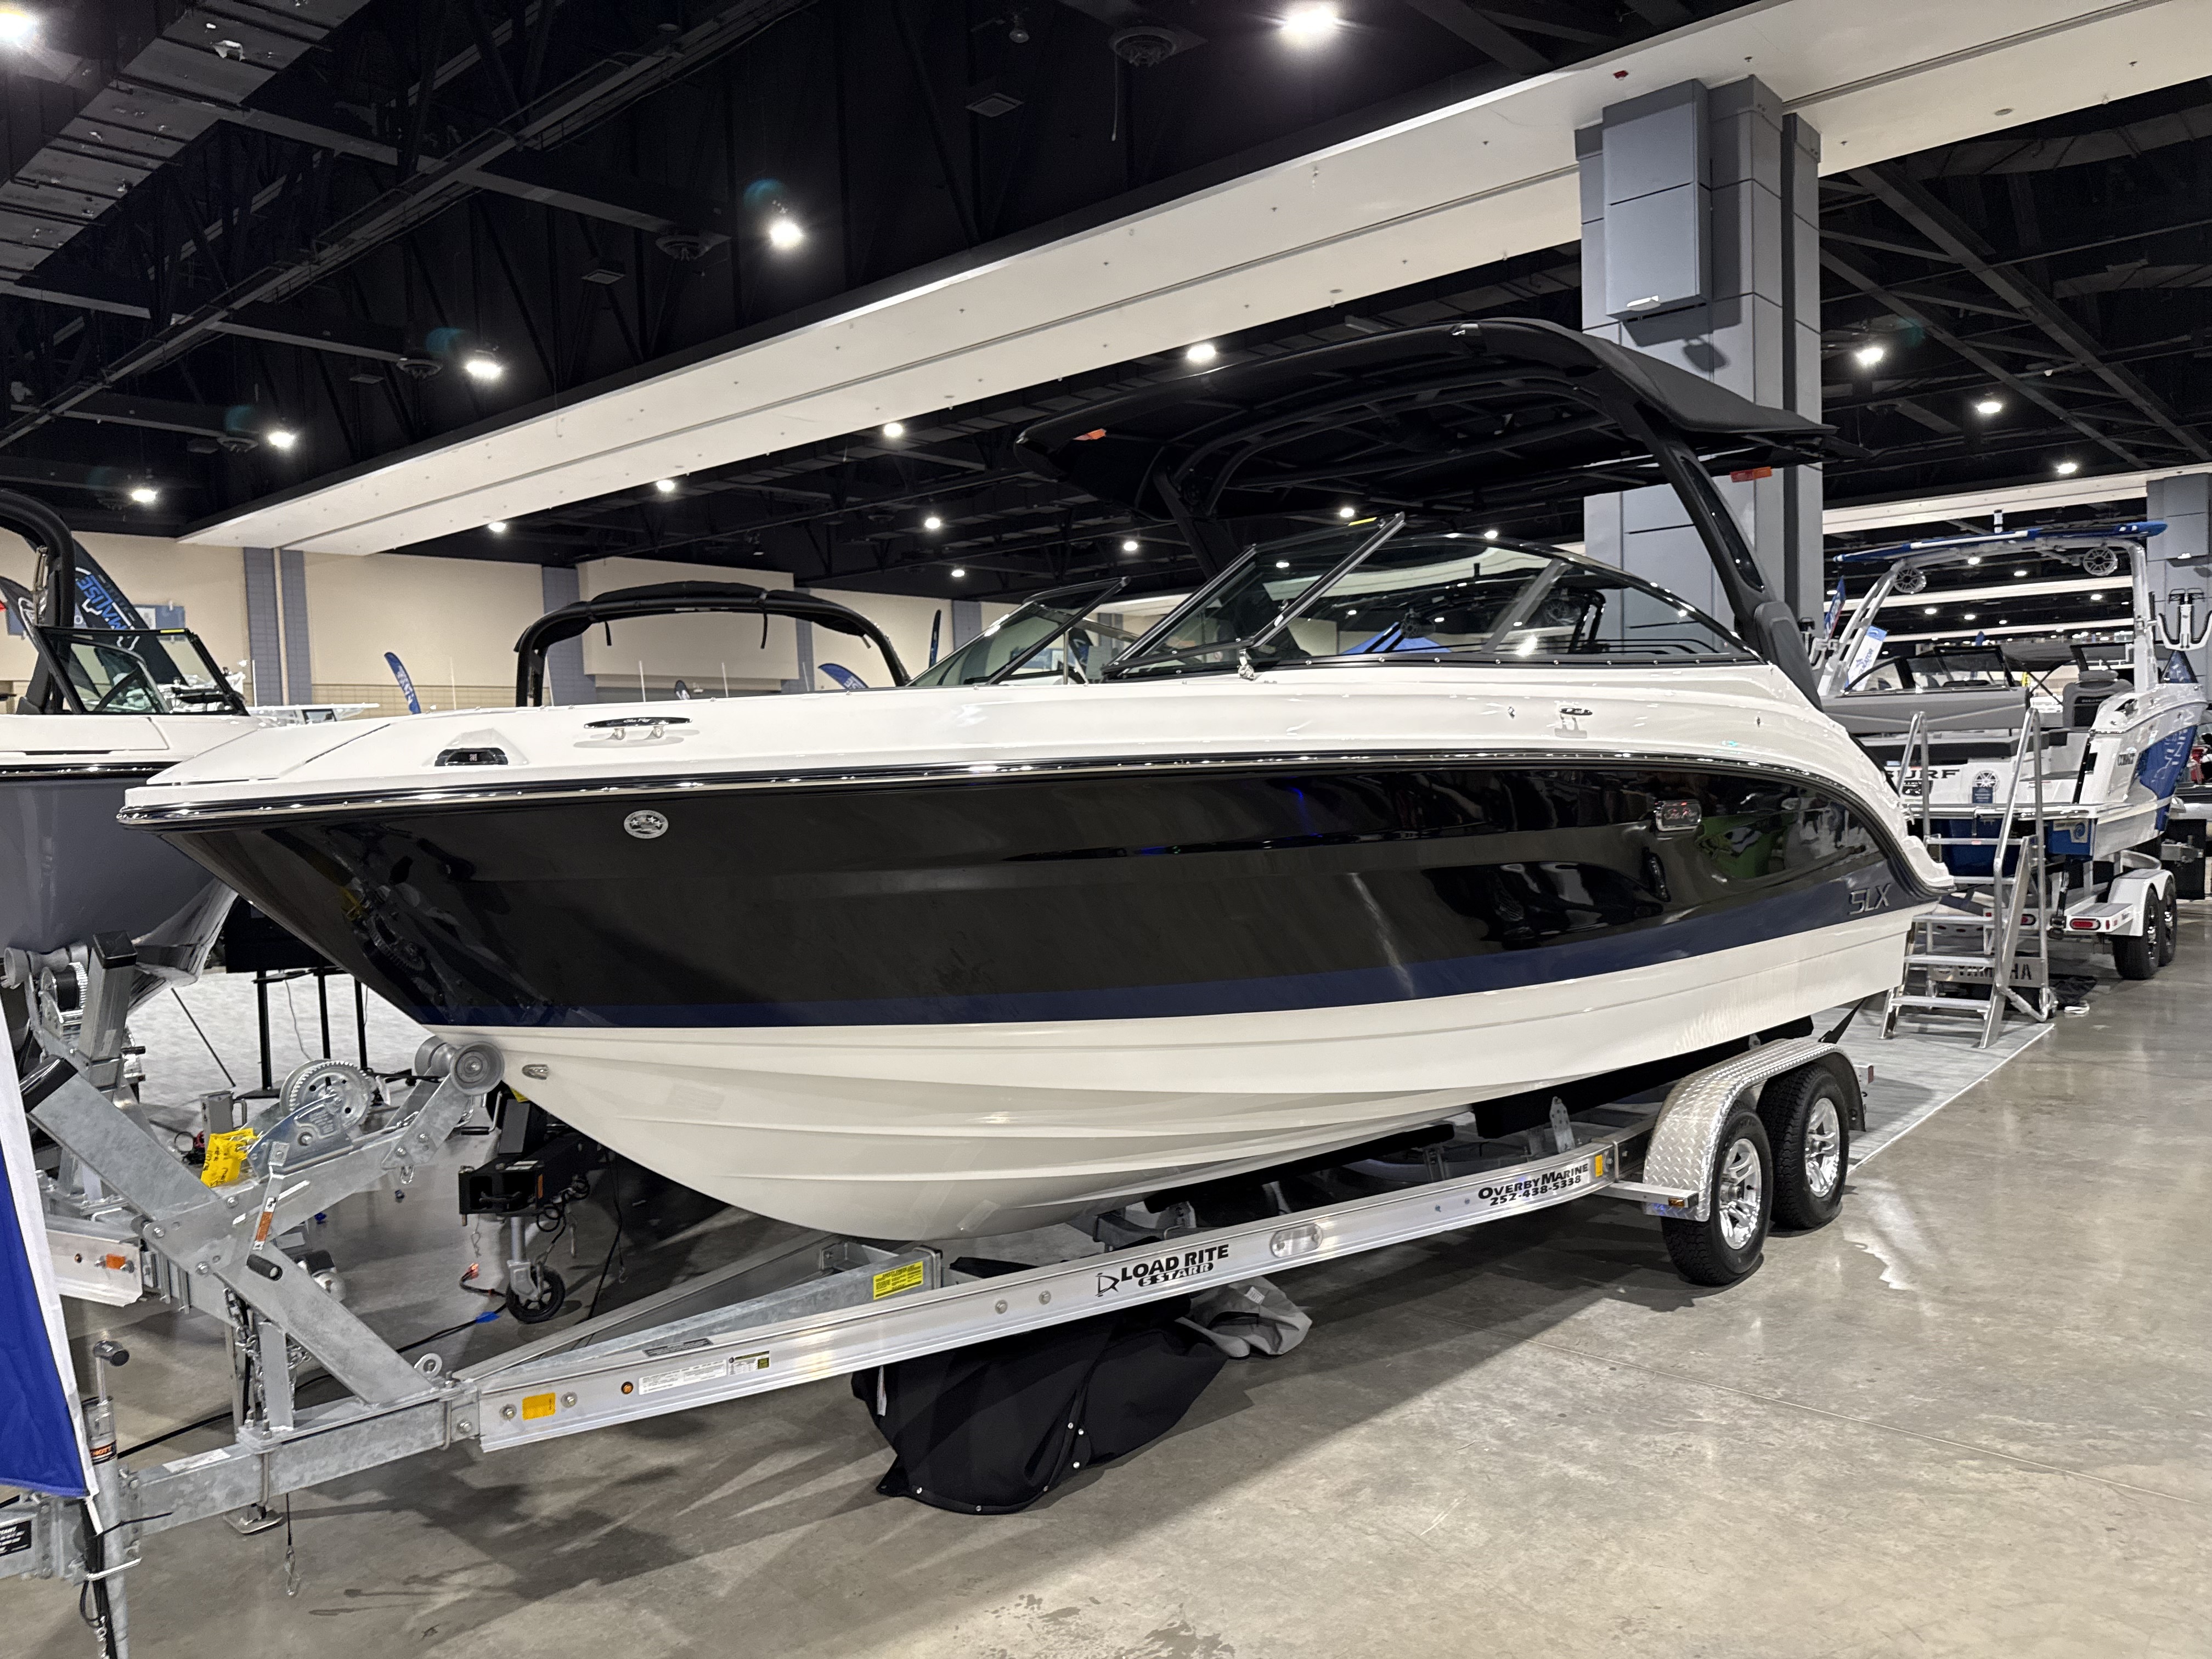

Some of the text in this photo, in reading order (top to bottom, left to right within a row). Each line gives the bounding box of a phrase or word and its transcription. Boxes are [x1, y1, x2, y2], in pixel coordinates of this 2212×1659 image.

[1848, 883, 1891, 915] SLX
[1957, 963, 2032, 980] YAMHA
[1479, 1164, 1588, 1199] OVERBY MARINE
[1490, 1175, 1581, 1206] 252-438-5338
[1121, 1244, 1229, 1282] LOAD RITE
[1142, 1277, 1152, 1286] 5
